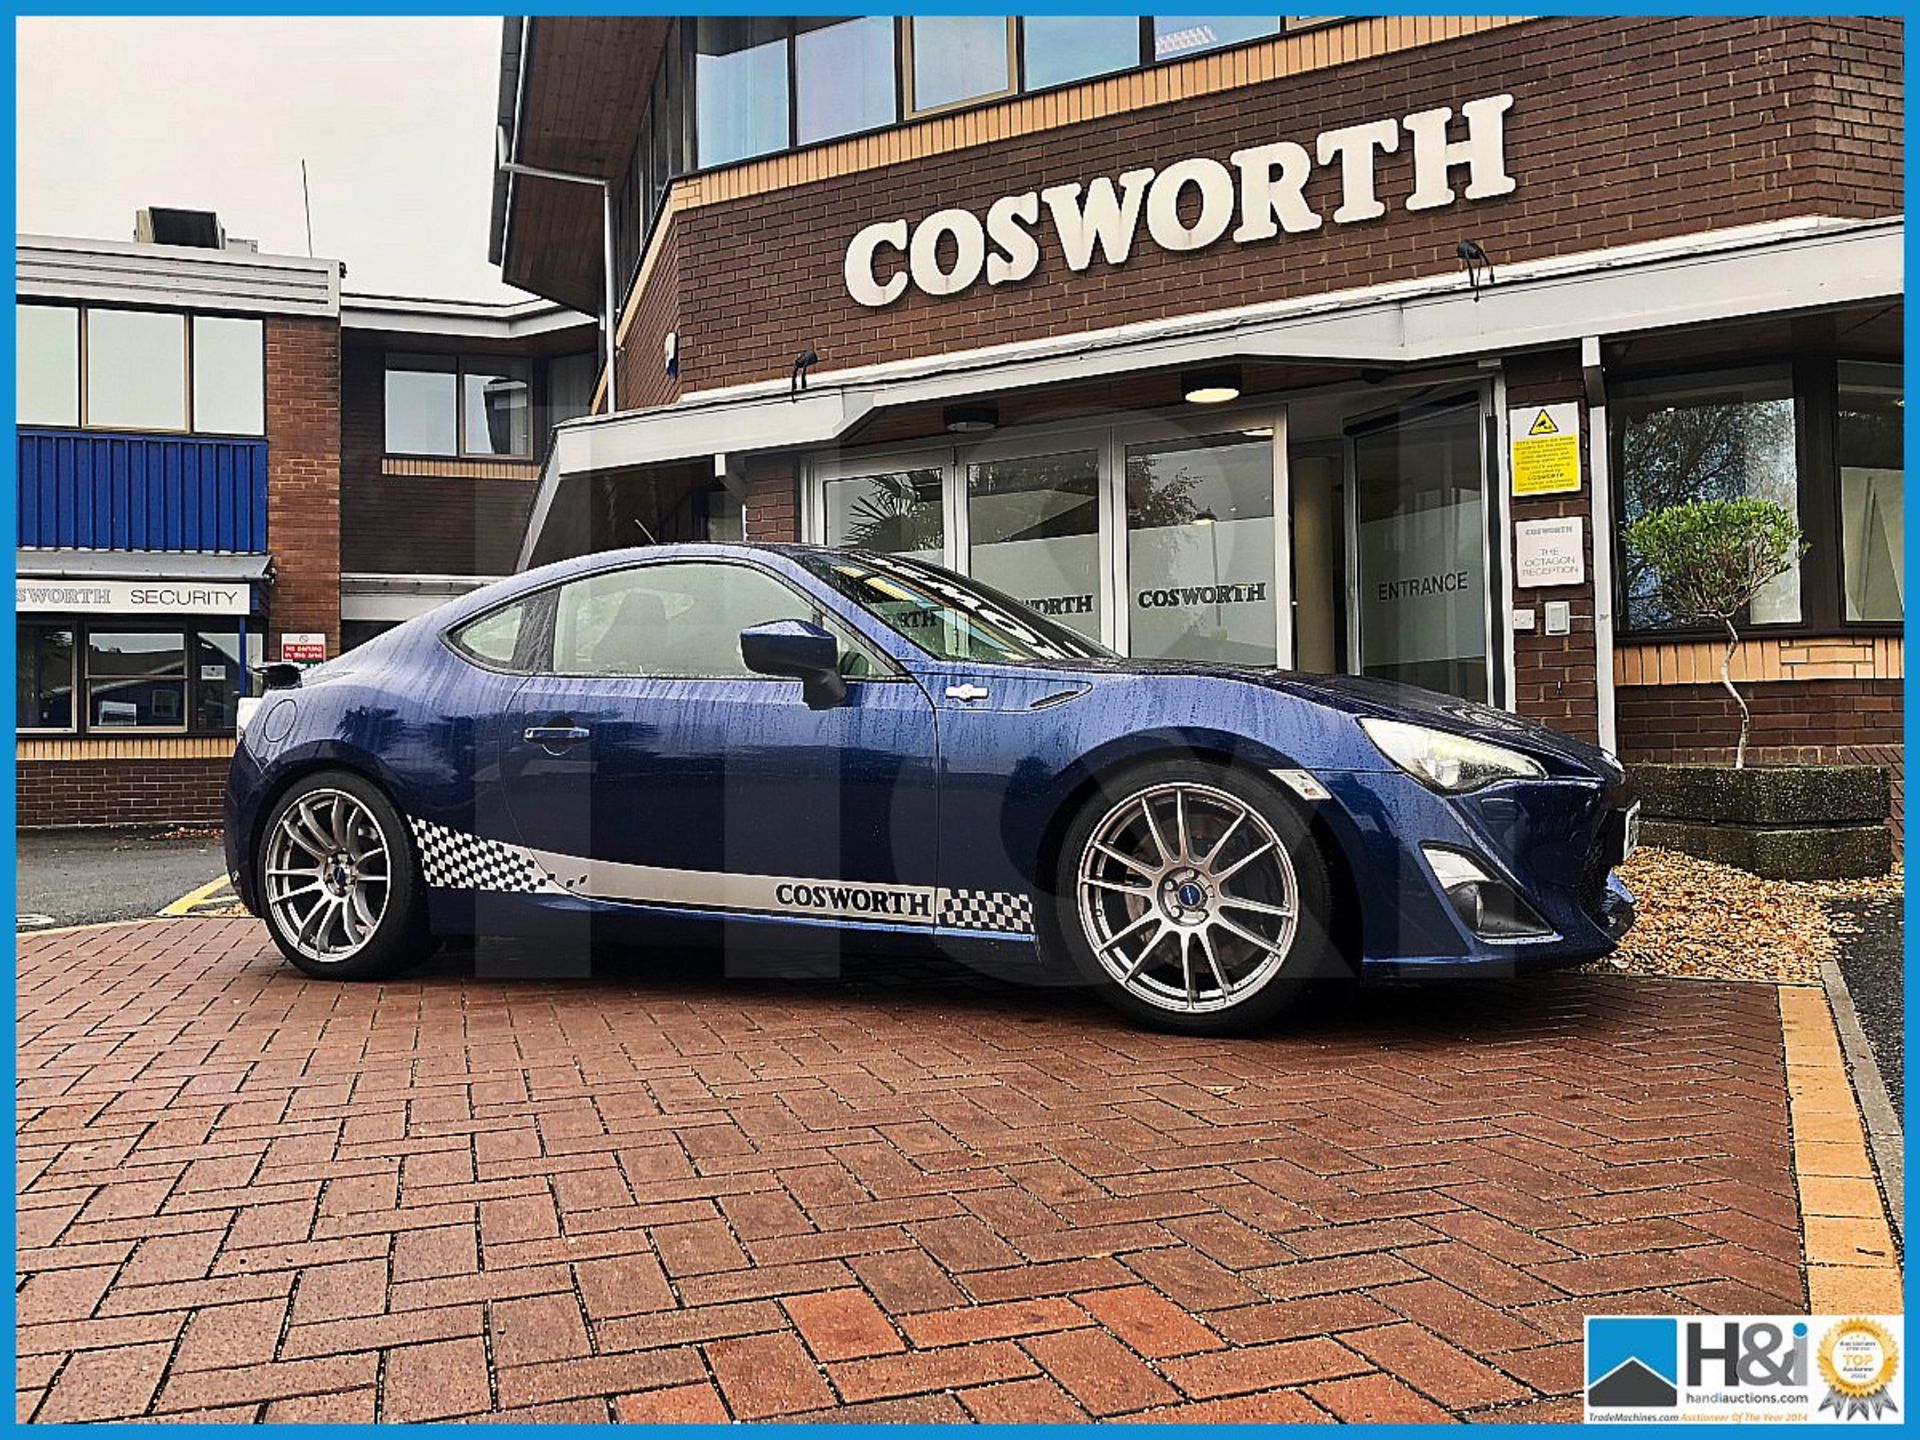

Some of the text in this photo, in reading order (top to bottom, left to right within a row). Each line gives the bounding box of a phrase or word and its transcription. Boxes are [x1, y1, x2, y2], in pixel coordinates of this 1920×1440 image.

[844, 93, 1517, 308] COSWORTH
[1524, 556, 1576, 567] OCTAGON
[1539, 548, 1560, 556] THE
[1522, 566, 1579, 577] RECEPTION
[1138, 582, 1266, 608] COSWORTH
[1377, 571, 1468, 601] ENTRANCE
[130, 589, 238, 605] SECURITY
[776, 884, 932, 917] COSWORTH
